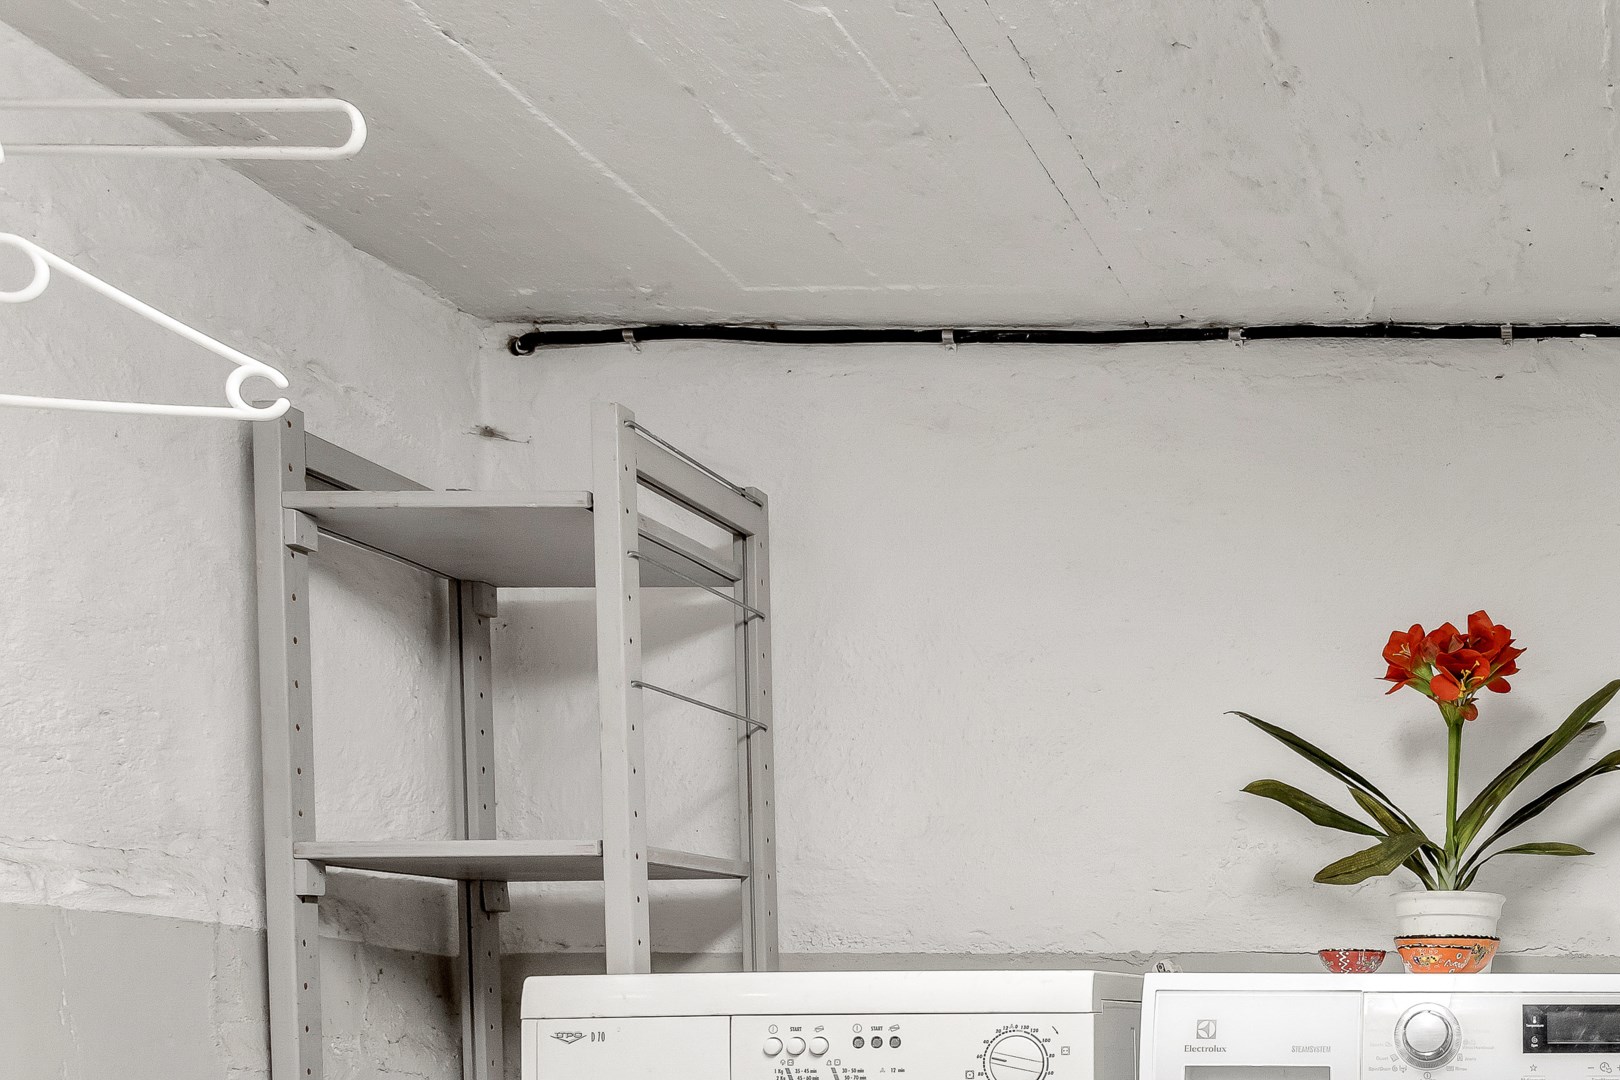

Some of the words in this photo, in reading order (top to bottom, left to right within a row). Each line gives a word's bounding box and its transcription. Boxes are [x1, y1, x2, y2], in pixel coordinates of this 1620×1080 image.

[591, 1031, 596, 1042] D
[597, 1031, 606, 1042] 70
[1184, 1045, 1227, 1053] Electrolux
